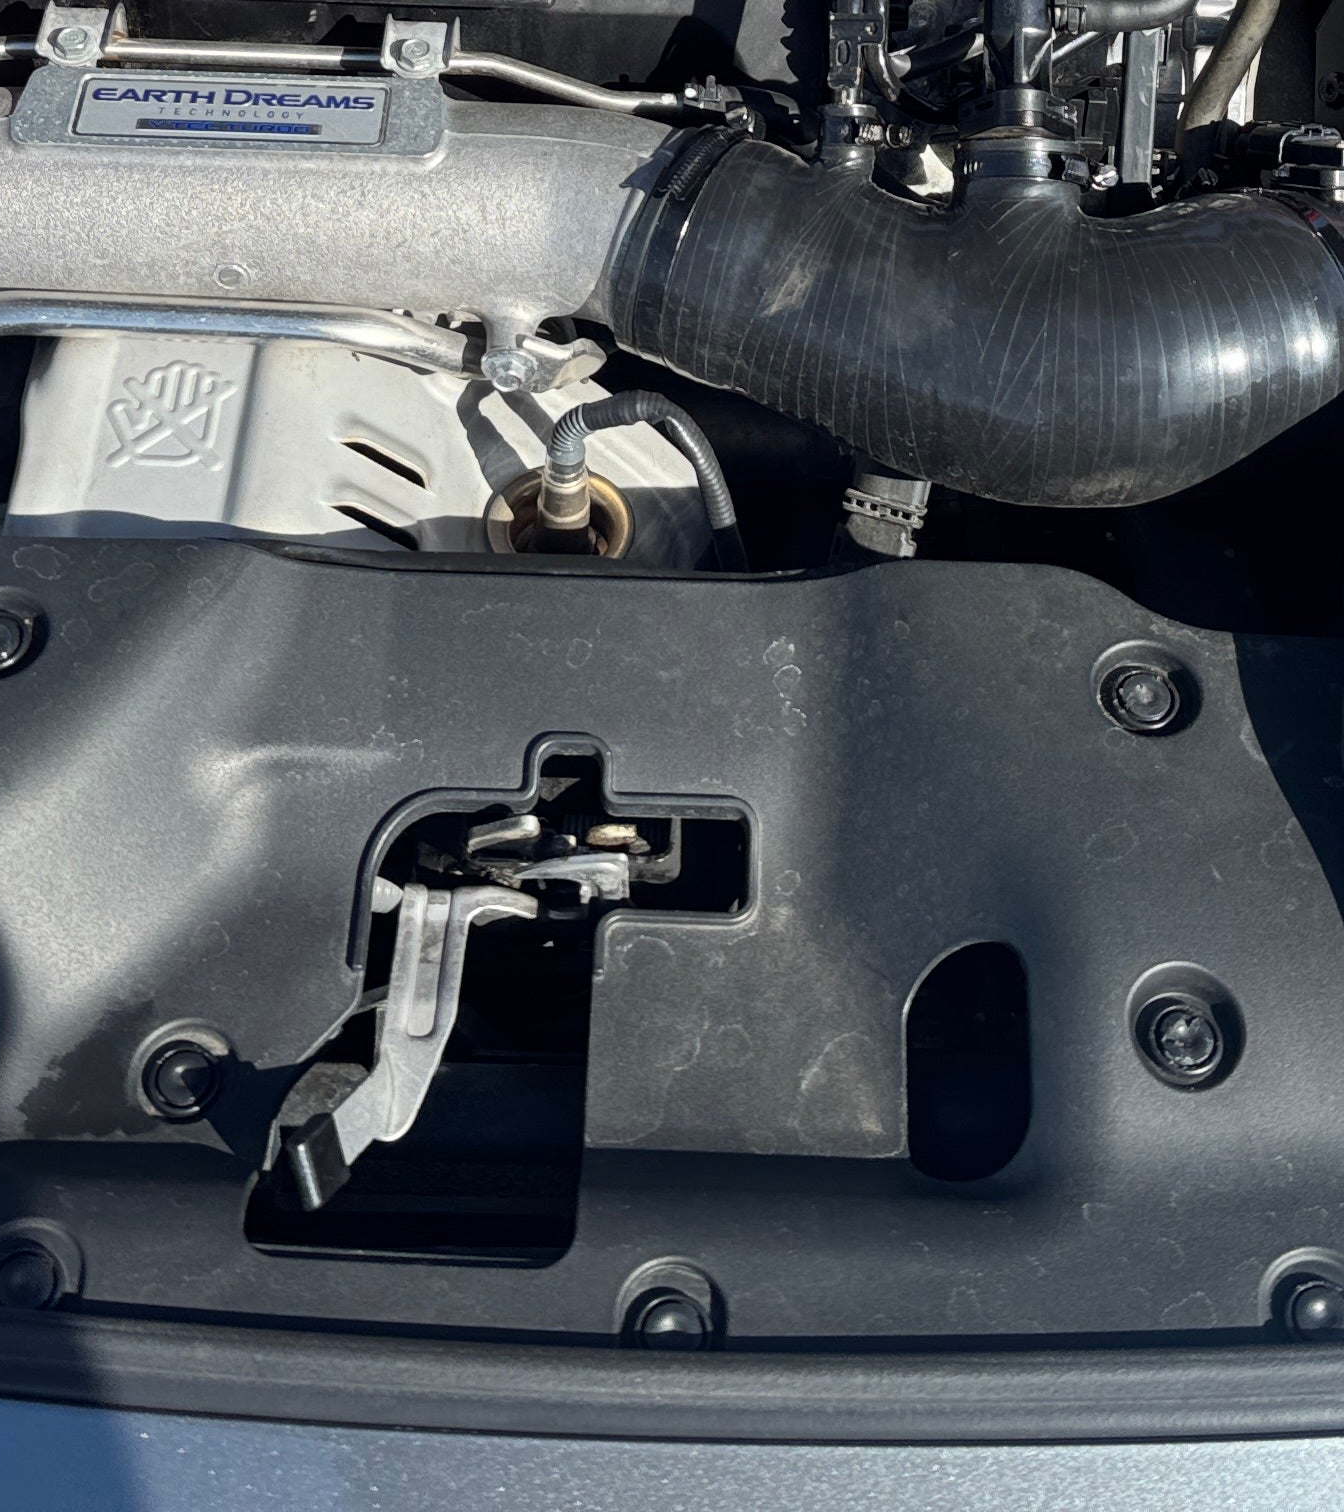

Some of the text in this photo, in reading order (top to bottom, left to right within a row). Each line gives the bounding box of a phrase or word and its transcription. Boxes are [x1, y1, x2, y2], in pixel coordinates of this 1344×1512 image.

[91, 87, 377, 111] EARTH DREAMS
[157, 105, 308, 121] TECHNOLOGY
